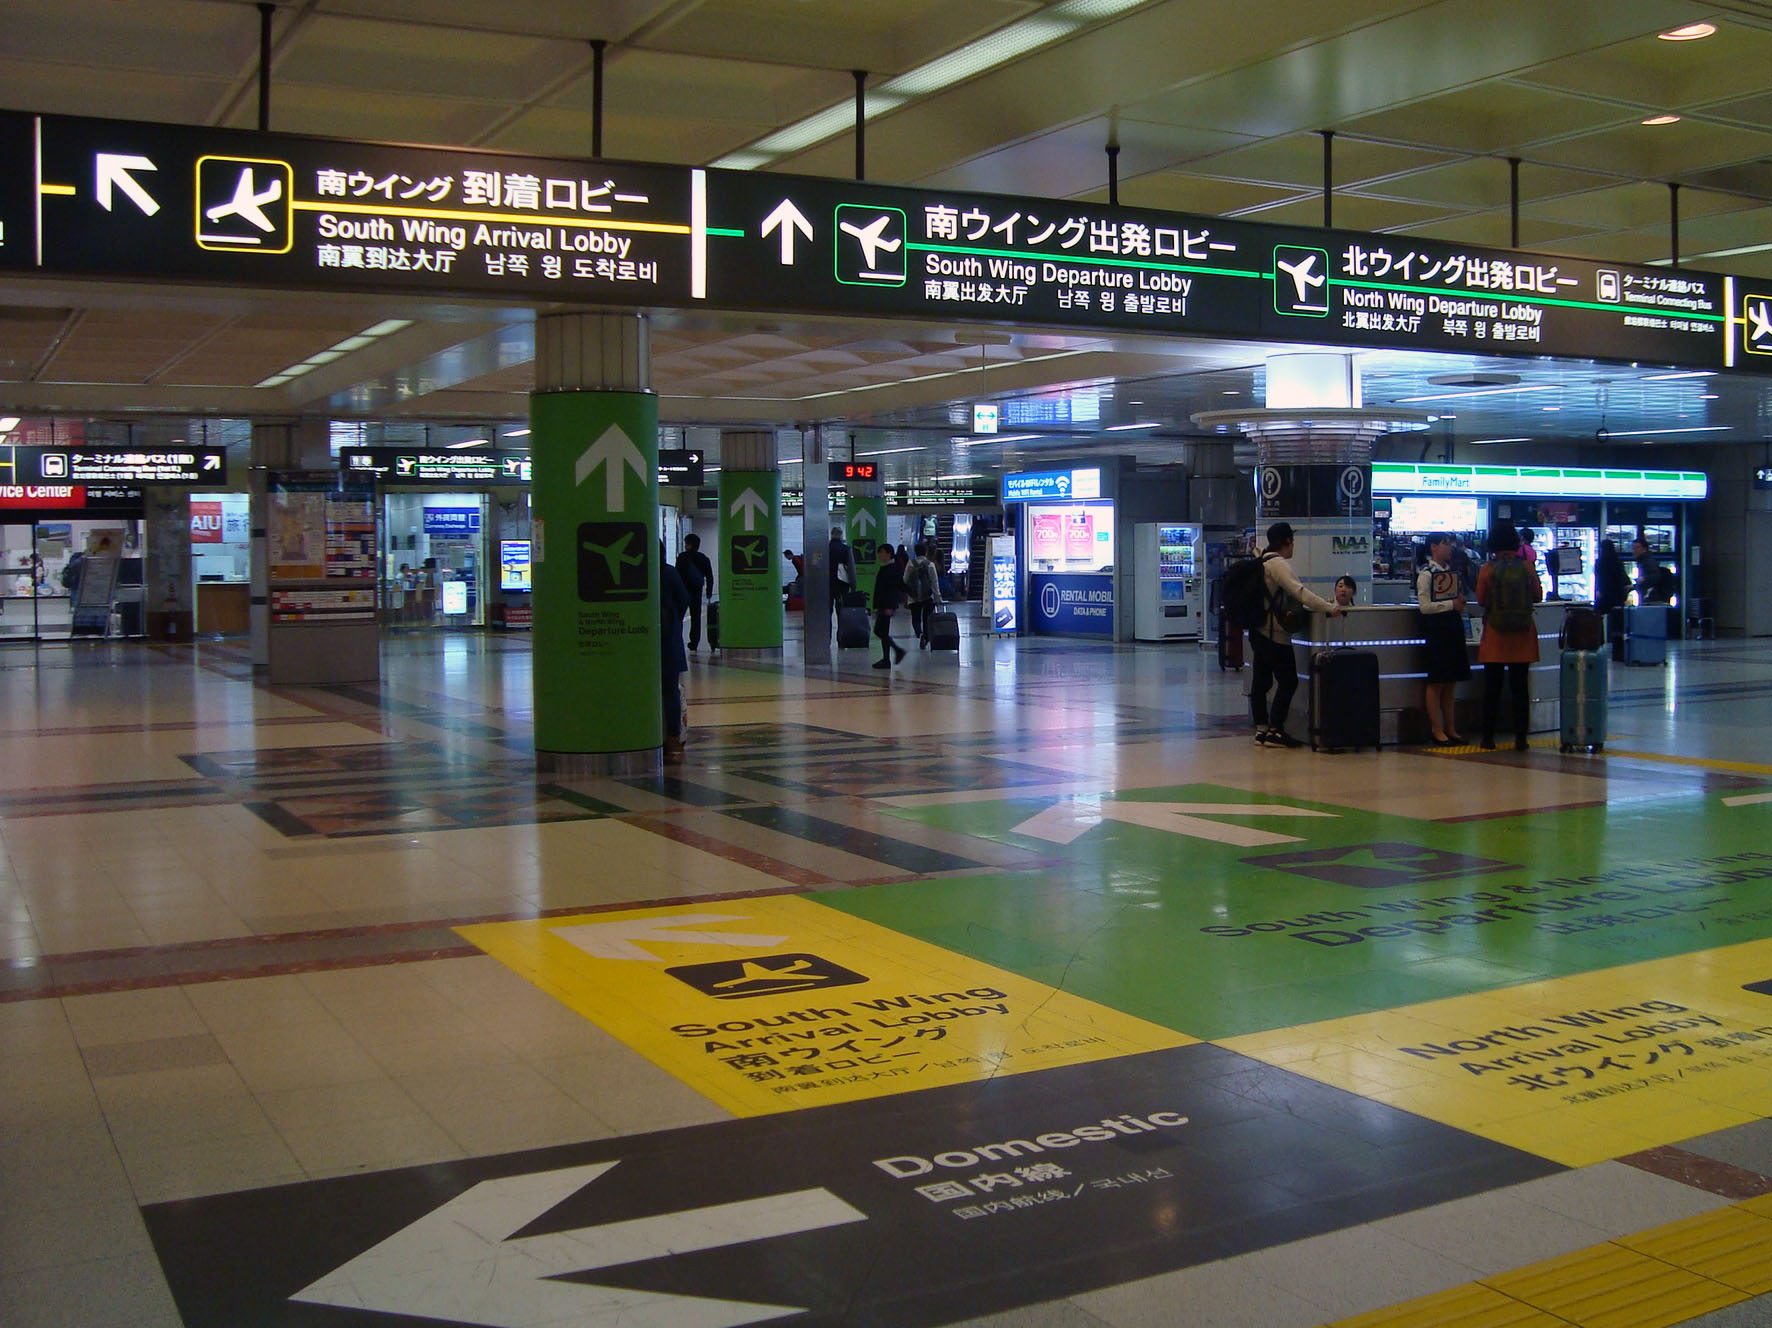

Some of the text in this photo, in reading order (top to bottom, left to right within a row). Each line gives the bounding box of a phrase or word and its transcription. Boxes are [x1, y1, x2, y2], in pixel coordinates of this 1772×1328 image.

[318, 213, 632, 260] South Wing Arrival Lobby
[924, 204, 1237, 260] 南ウイング出発ロビー
[316, 243, 457, 274] 南翼到达大厅
[485, 252, 658, 284] 남쪽 윙 도착로비
[925, 254, 1192, 297] South Wing Departure Lobby
[1342, 245, 1579, 294] 北ウイング出発ロビー
[924, 279, 1029, 305] 南翼出发大厅
[1057, 288, 1187, 317] 남쪽 윙 출발로비
[1343, 288, 1543, 326] North Wing Departure Lobby
[1697, 298, 1713, 311] Bus
[1342, 311, 1421, 333] 北翼出发大厅
[26, 485, 74, 498] Center
[1421, 476, 1470, 489] FamilyMart
[190, 515, 221, 530] AIU
[1060, 589, 1088, 602] RENTAL
[1200, 909, 1372, 938] South
[1359, 891, 1512, 914] Wing
[1288, 890, 1641, 948] Departure
[669, 986, 1009, 1039] South Wing
[704, 1001, 1011, 1055] Arrival Lobby
[1398, 999, 1690, 1061] North Wing
[717, 1024, 950, 1071] 南ウイング
[1459, 1014, 1723, 1077] Arrival Lobby
[742, 1051, 922, 1084] 到着ロビー
[871, 1110, 1190, 1180] Domestic
[914, 1162, 1073, 1203] 国内線
